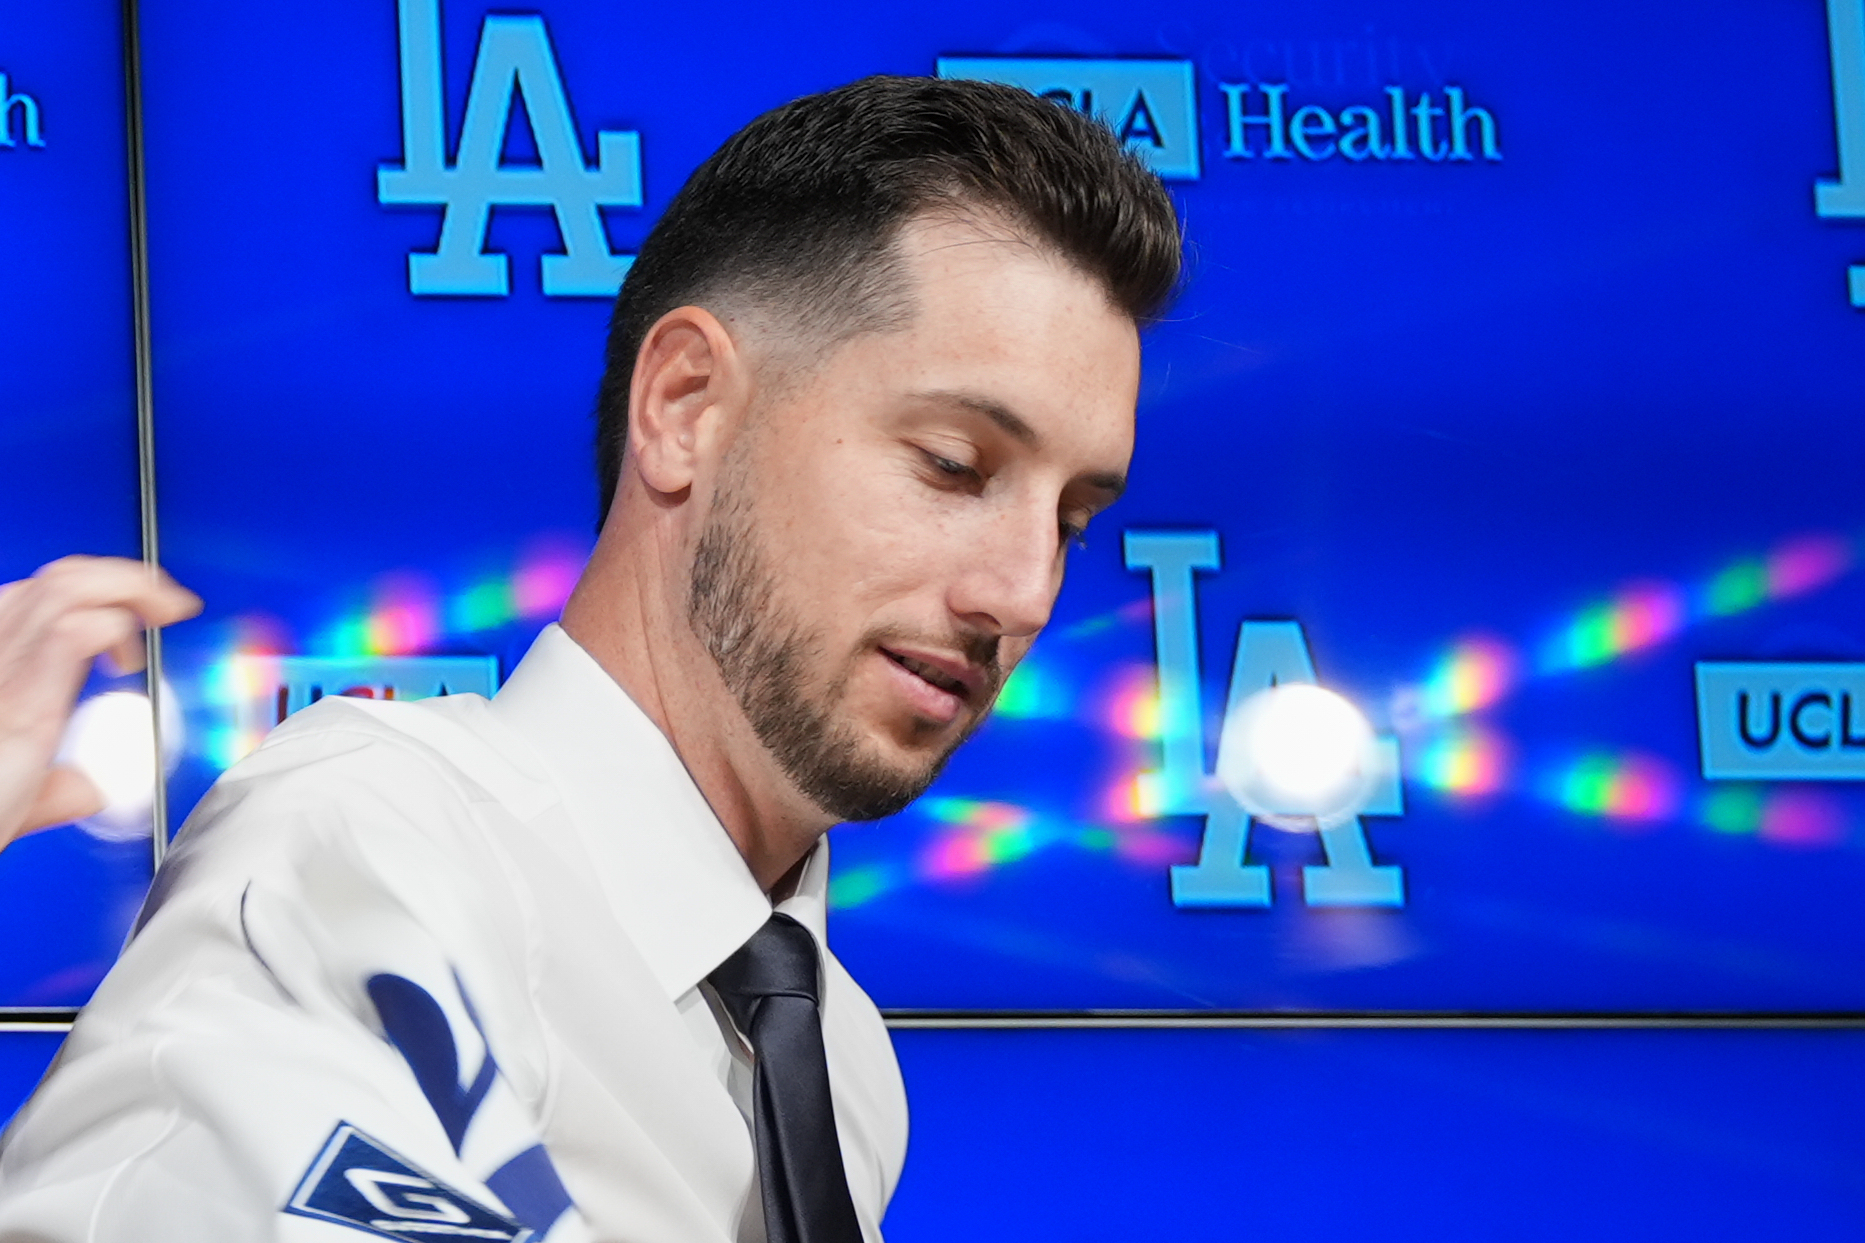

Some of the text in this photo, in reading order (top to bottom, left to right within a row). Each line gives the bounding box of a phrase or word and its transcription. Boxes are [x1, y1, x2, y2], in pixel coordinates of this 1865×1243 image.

[377, 0, 643, 296] LA
[1219, 82, 1503, 161] Health
[1123, 530, 1405, 908] LA
